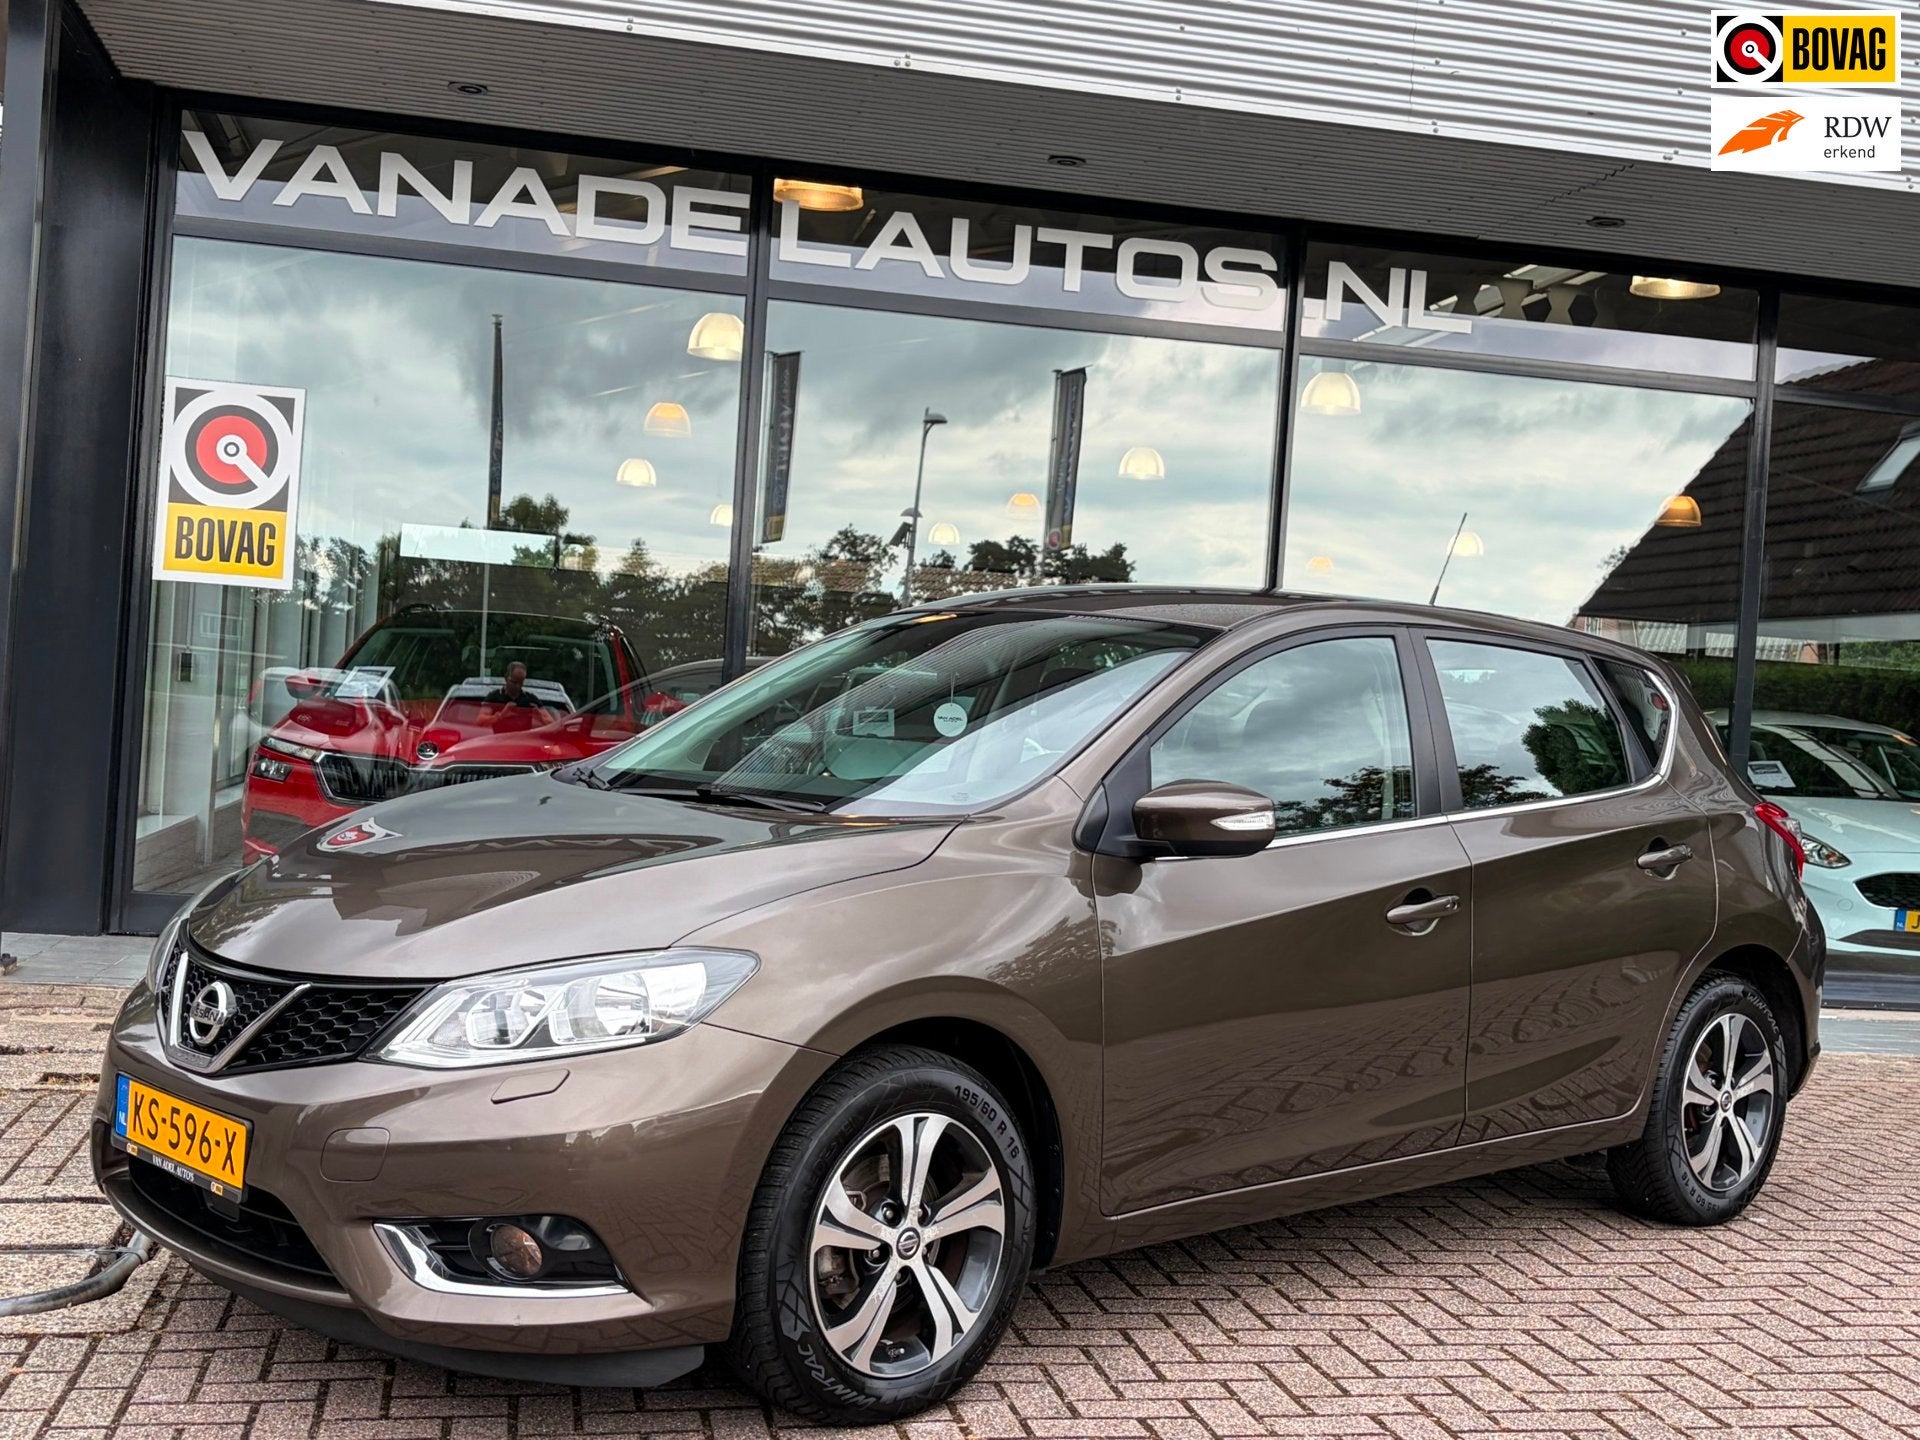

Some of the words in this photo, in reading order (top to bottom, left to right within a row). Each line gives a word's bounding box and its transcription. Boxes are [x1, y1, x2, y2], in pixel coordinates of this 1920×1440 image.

[175, 516, 276, 566] BOVAG
[1746, 992, 1779, 1034] WINTRAC
[119, 1111, 127, 1126] NL
[132, 1091, 237, 1176] KS-596-X
[955, 1085, 997, 1122] 195/60
[997, 1120, 1007, 1136] R
[1007, 1137, 1020, 1159] 16
[797, 1343, 877, 1411] WINTRAC
